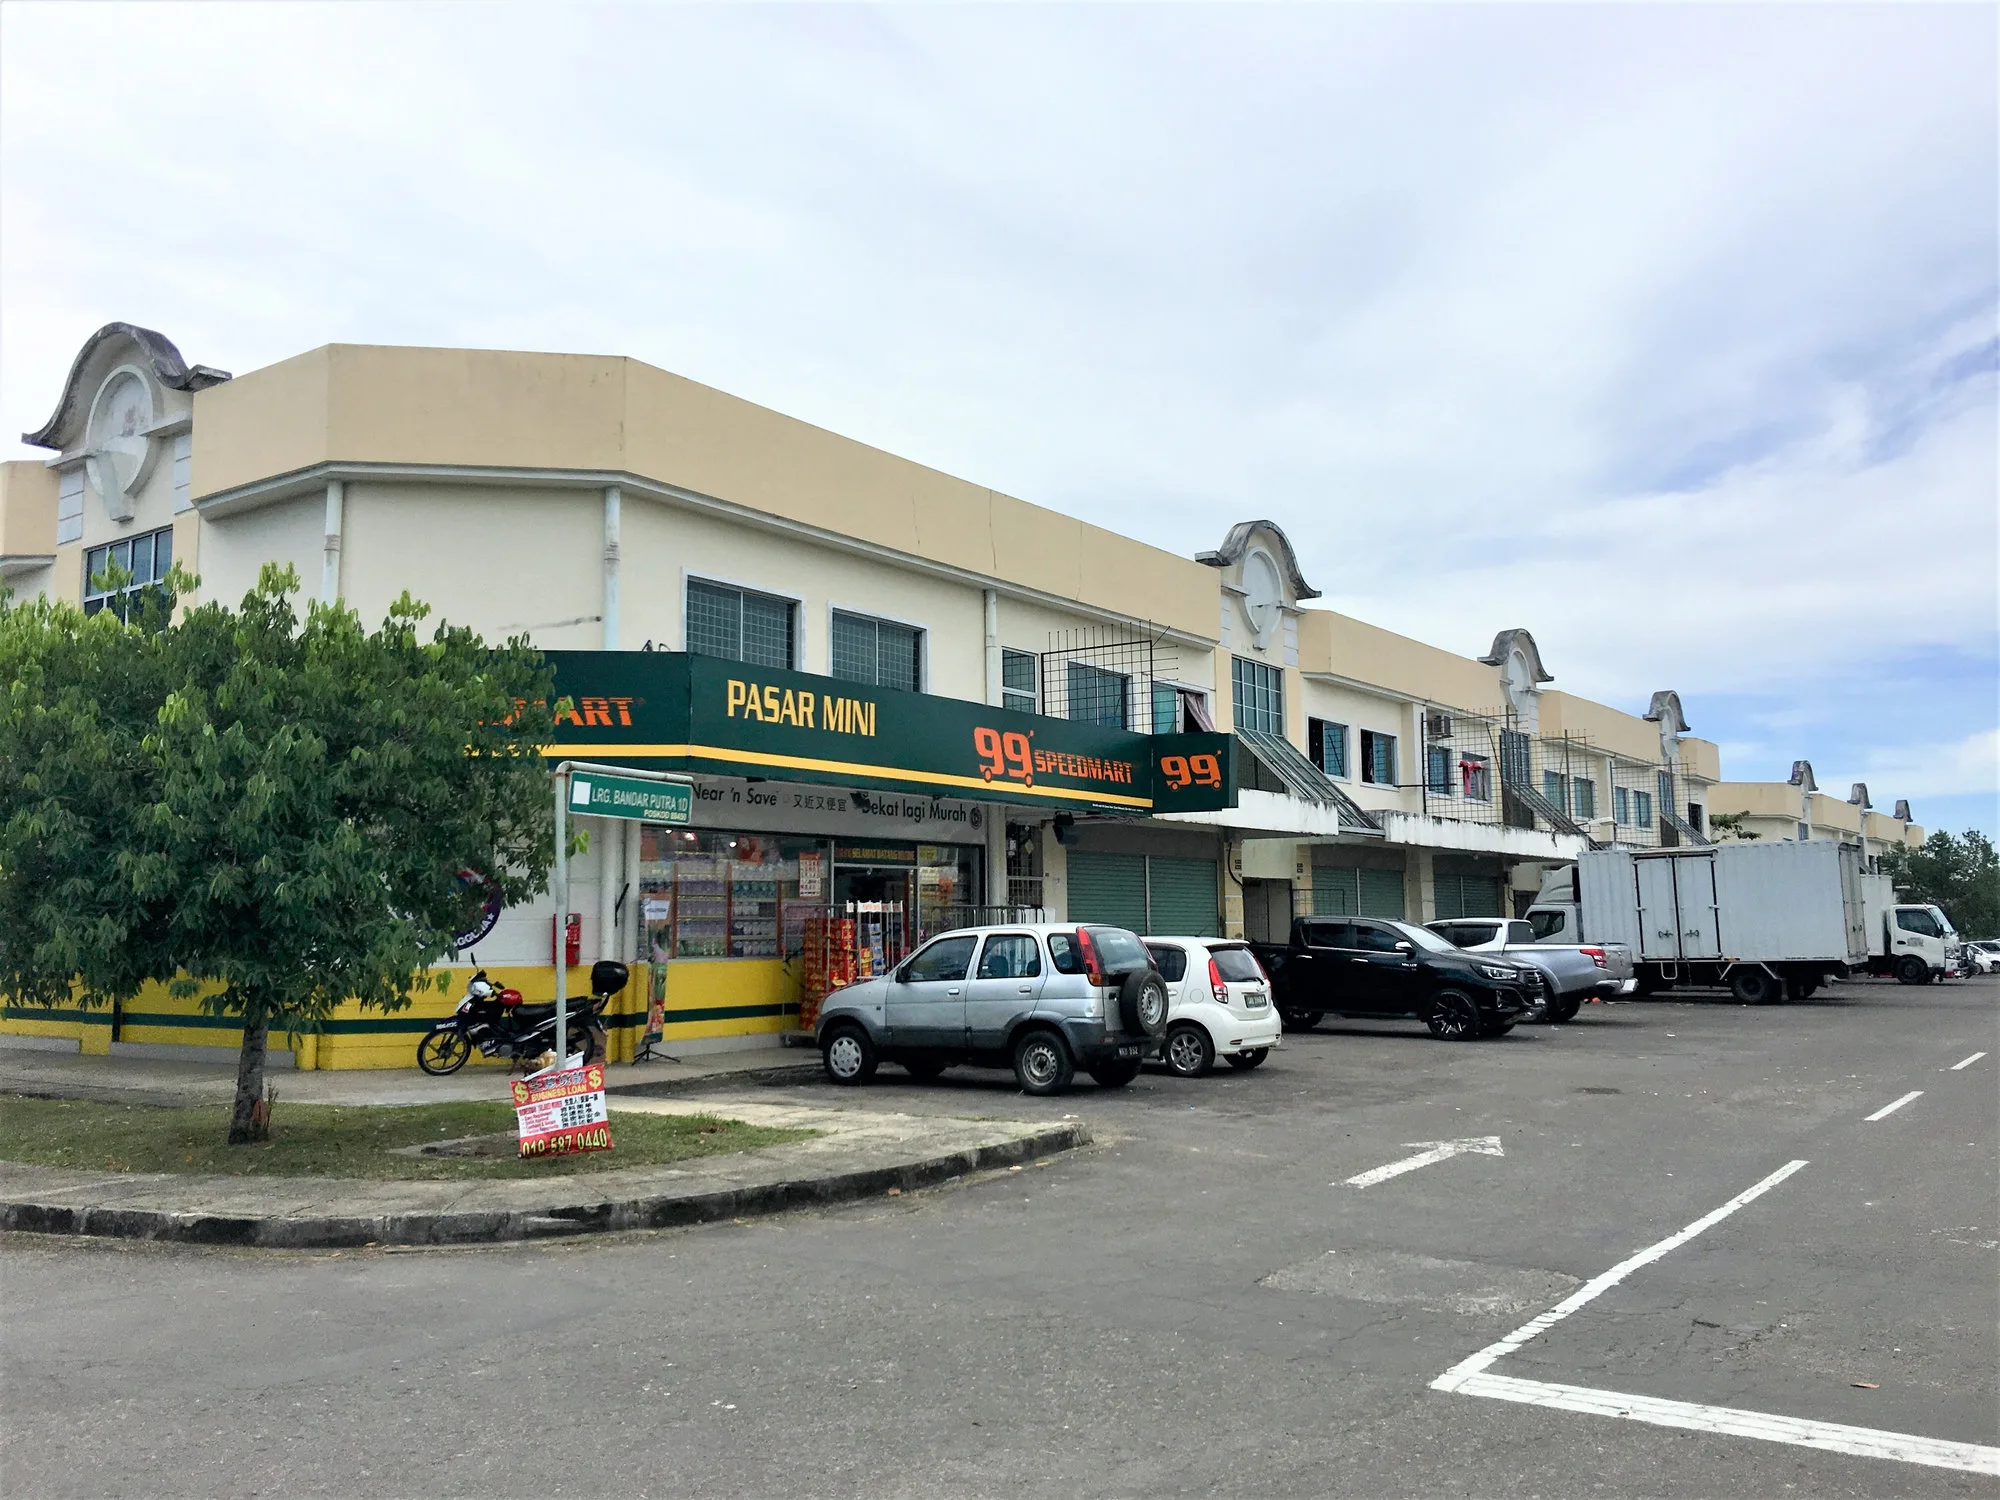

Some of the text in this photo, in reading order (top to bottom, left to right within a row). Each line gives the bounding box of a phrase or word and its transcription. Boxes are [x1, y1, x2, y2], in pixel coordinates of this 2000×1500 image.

[727, 679, 876, 736] PASAR MINI
[974, 726, 1132, 783] 99 SPEEDMART
[1160, 754, 1221, 787] 99
[591, 787, 612, 804] LRG.
[613, 790, 649, 807] BANDAR
[649, 794, 677, 811] PUTRA
[691, 783, 725, 801] Near
[746, 787, 778, 807] Save
[793, 794, 847, 812] 又近又便宜
[643, 809, 669, 819] POSKOD
[902, 799, 925, 823] lagi
[929, 802, 967, 822] Murah
[531, 1087, 567, 1102] BUSINESS
[567, 1084, 587, 1095] LOAN
[577, 1127, 607, 1150] 0440
